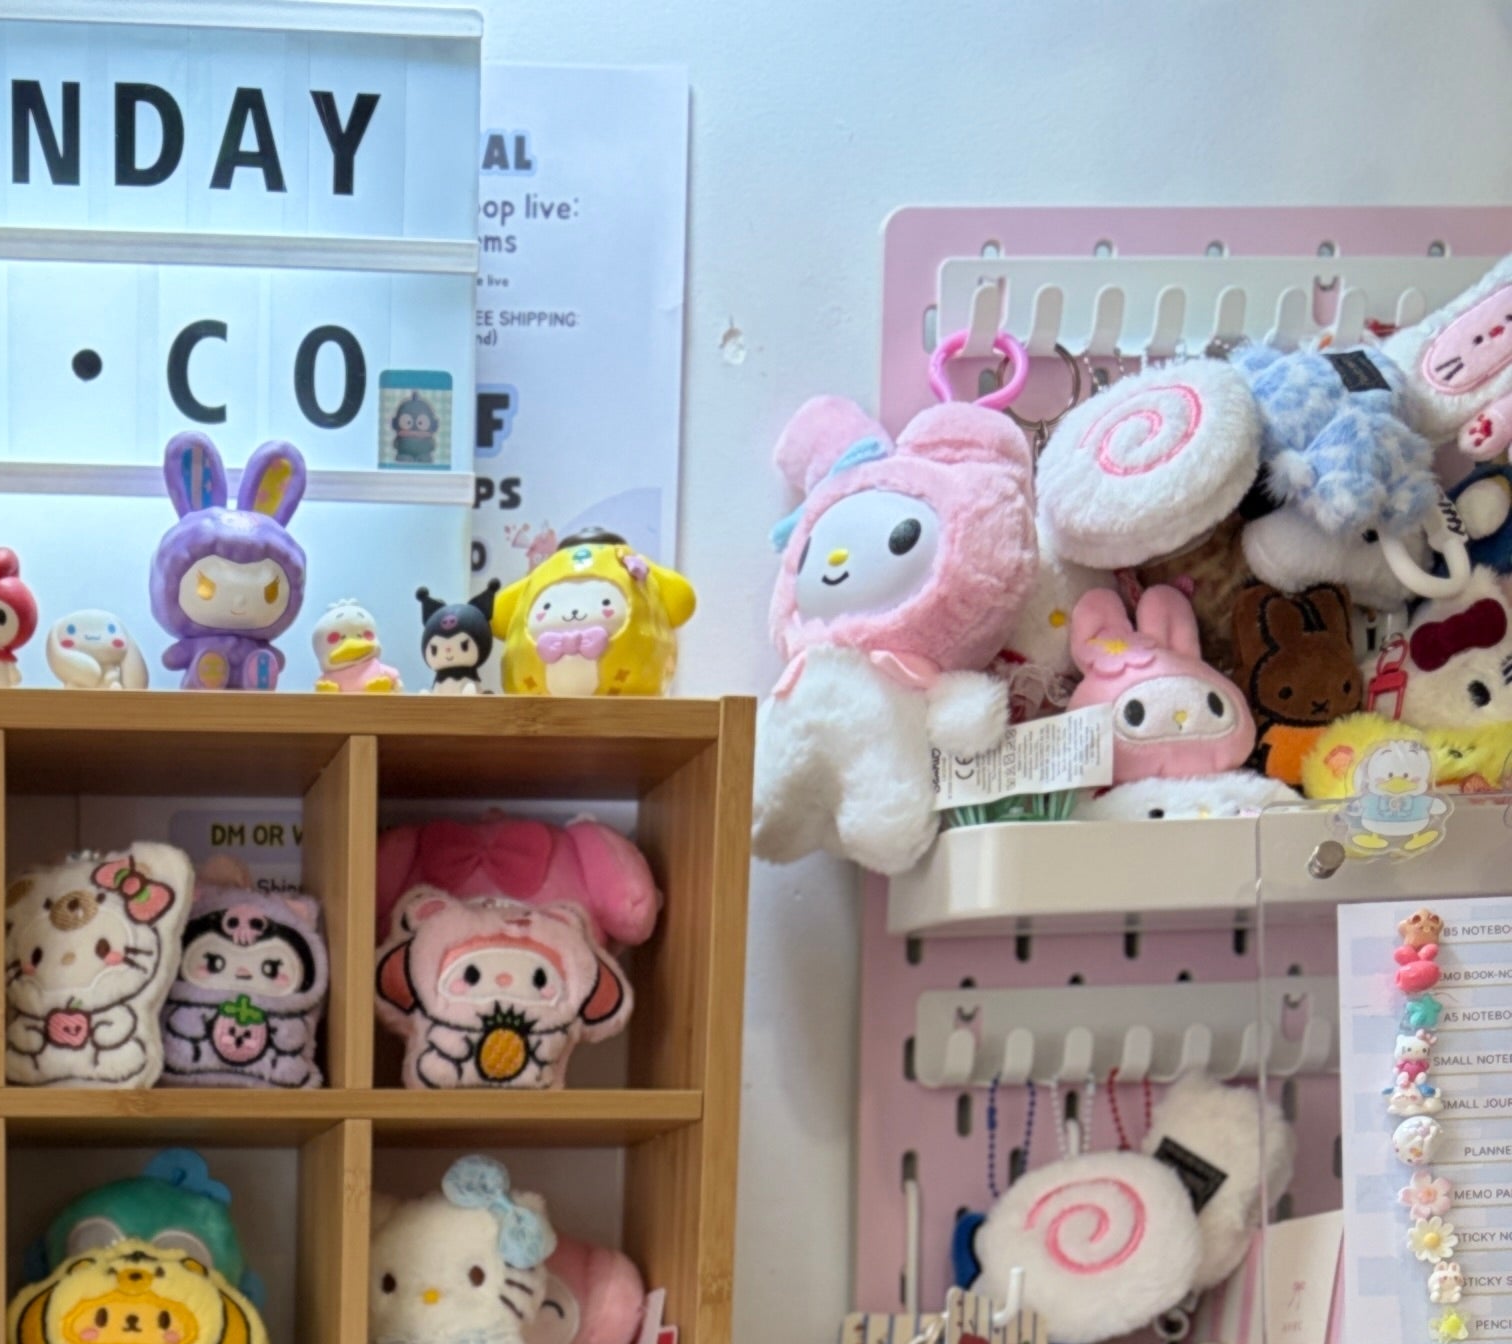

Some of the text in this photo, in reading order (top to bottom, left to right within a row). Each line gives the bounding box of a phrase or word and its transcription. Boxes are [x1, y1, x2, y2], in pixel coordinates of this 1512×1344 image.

[211, 824, 245, 847] DM
[252, 824, 284, 847] OR
[1433, 1055, 1472, 1067] SMALL
[1454, 1189, 1492, 1200] MEMO
[1463, 1276, 1502, 1287] TICKY
